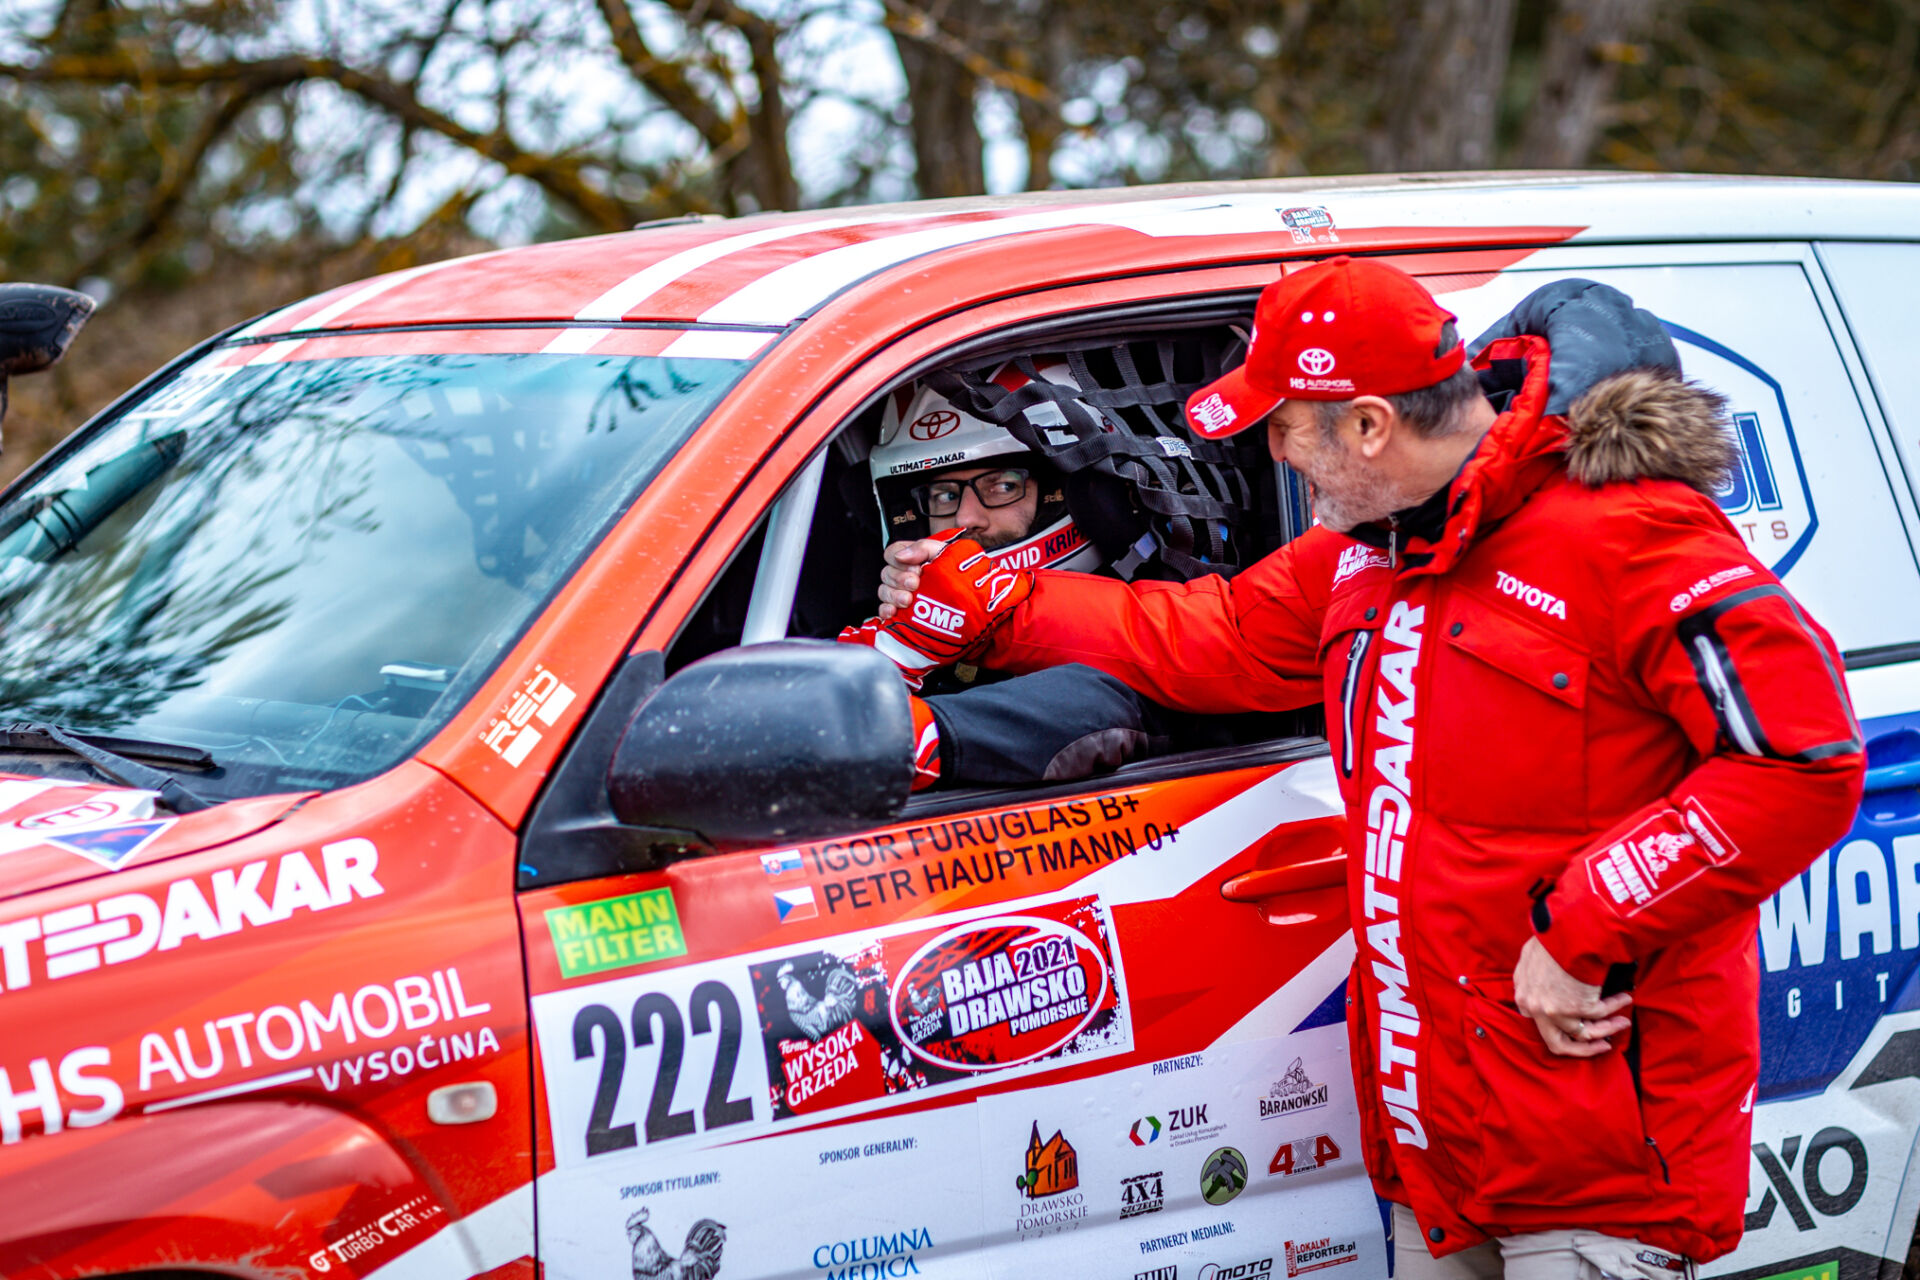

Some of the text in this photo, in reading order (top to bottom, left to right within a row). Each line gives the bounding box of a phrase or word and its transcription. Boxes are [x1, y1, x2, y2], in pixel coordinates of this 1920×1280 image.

[999, 546, 1041, 571] AVID
[1043, 526, 1083, 558] KRIP
[1496, 571, 1566, 620] TOYOTA
[913, 601, 965, 631] OMP
[484, 669, 559, 754] RED
[809, 794, 1139, 875] IGOR FURUGLAS B+
[823, 869, 918, 914] PETR
[922, 828, 1138, 893] HAUPTMANN
[0, 837, 385, 994] TEDAKAR
[553, 893, 672, 941] MANN
[562, 923, 679, 970] FILTER
[942, 935, 1078, 1004] BAJA 2021
[948, 964, 1088, 1038] DRAWSKO
[1010, 996, 1089, 1037] POMORSKIE
[138, 967, 491, 1091] AUTOMOBIL
[910, 1007, 944, 1034] WYSOKA
[315, 1025, 500, 1092] VYSOČINA
[778, 1038, 809, 1055] Ferma
[784, 1021, 863, 1083] WYSOKA
[1152, 1053, 1204, 1076] PARTNERZY:
[572, 979, 754, 1159] 222
[786, 1053, 859, 1108] GRZĘDA
[0, 1046, 125, 1144] HS
[1259, 1085, 1328, 1117] BARANOWSKI
[1168, 1103, 1208, 1132] ZUK
[819, 1137, 918, 1165] SPONSOR GENERALNY:
[620, 1171, 721, 1200] SPONSOR TYTULARNY:
[1121, 1178, 1164, 1205] 4X4
[1743, 1126, 1869, 1233] XO
[1016, 1205, 1089, 1233] POMORSKIE
[1020, 1193, 1084, 1217] DRAWSKO
[1121, 1199, 1164, 1216] SZCZECIN
[813, 1226, 934, 1269] COLUMNA
[1140, 1221, 1236, 1254] PARTNERZY MEDIALNI:
[1295, 1237, 1331, 1254] LOKALNY
[1296, 1241, 1356, 1264] REPORTER.pl
[1216, 1258, 1273, 1280] MOTO
